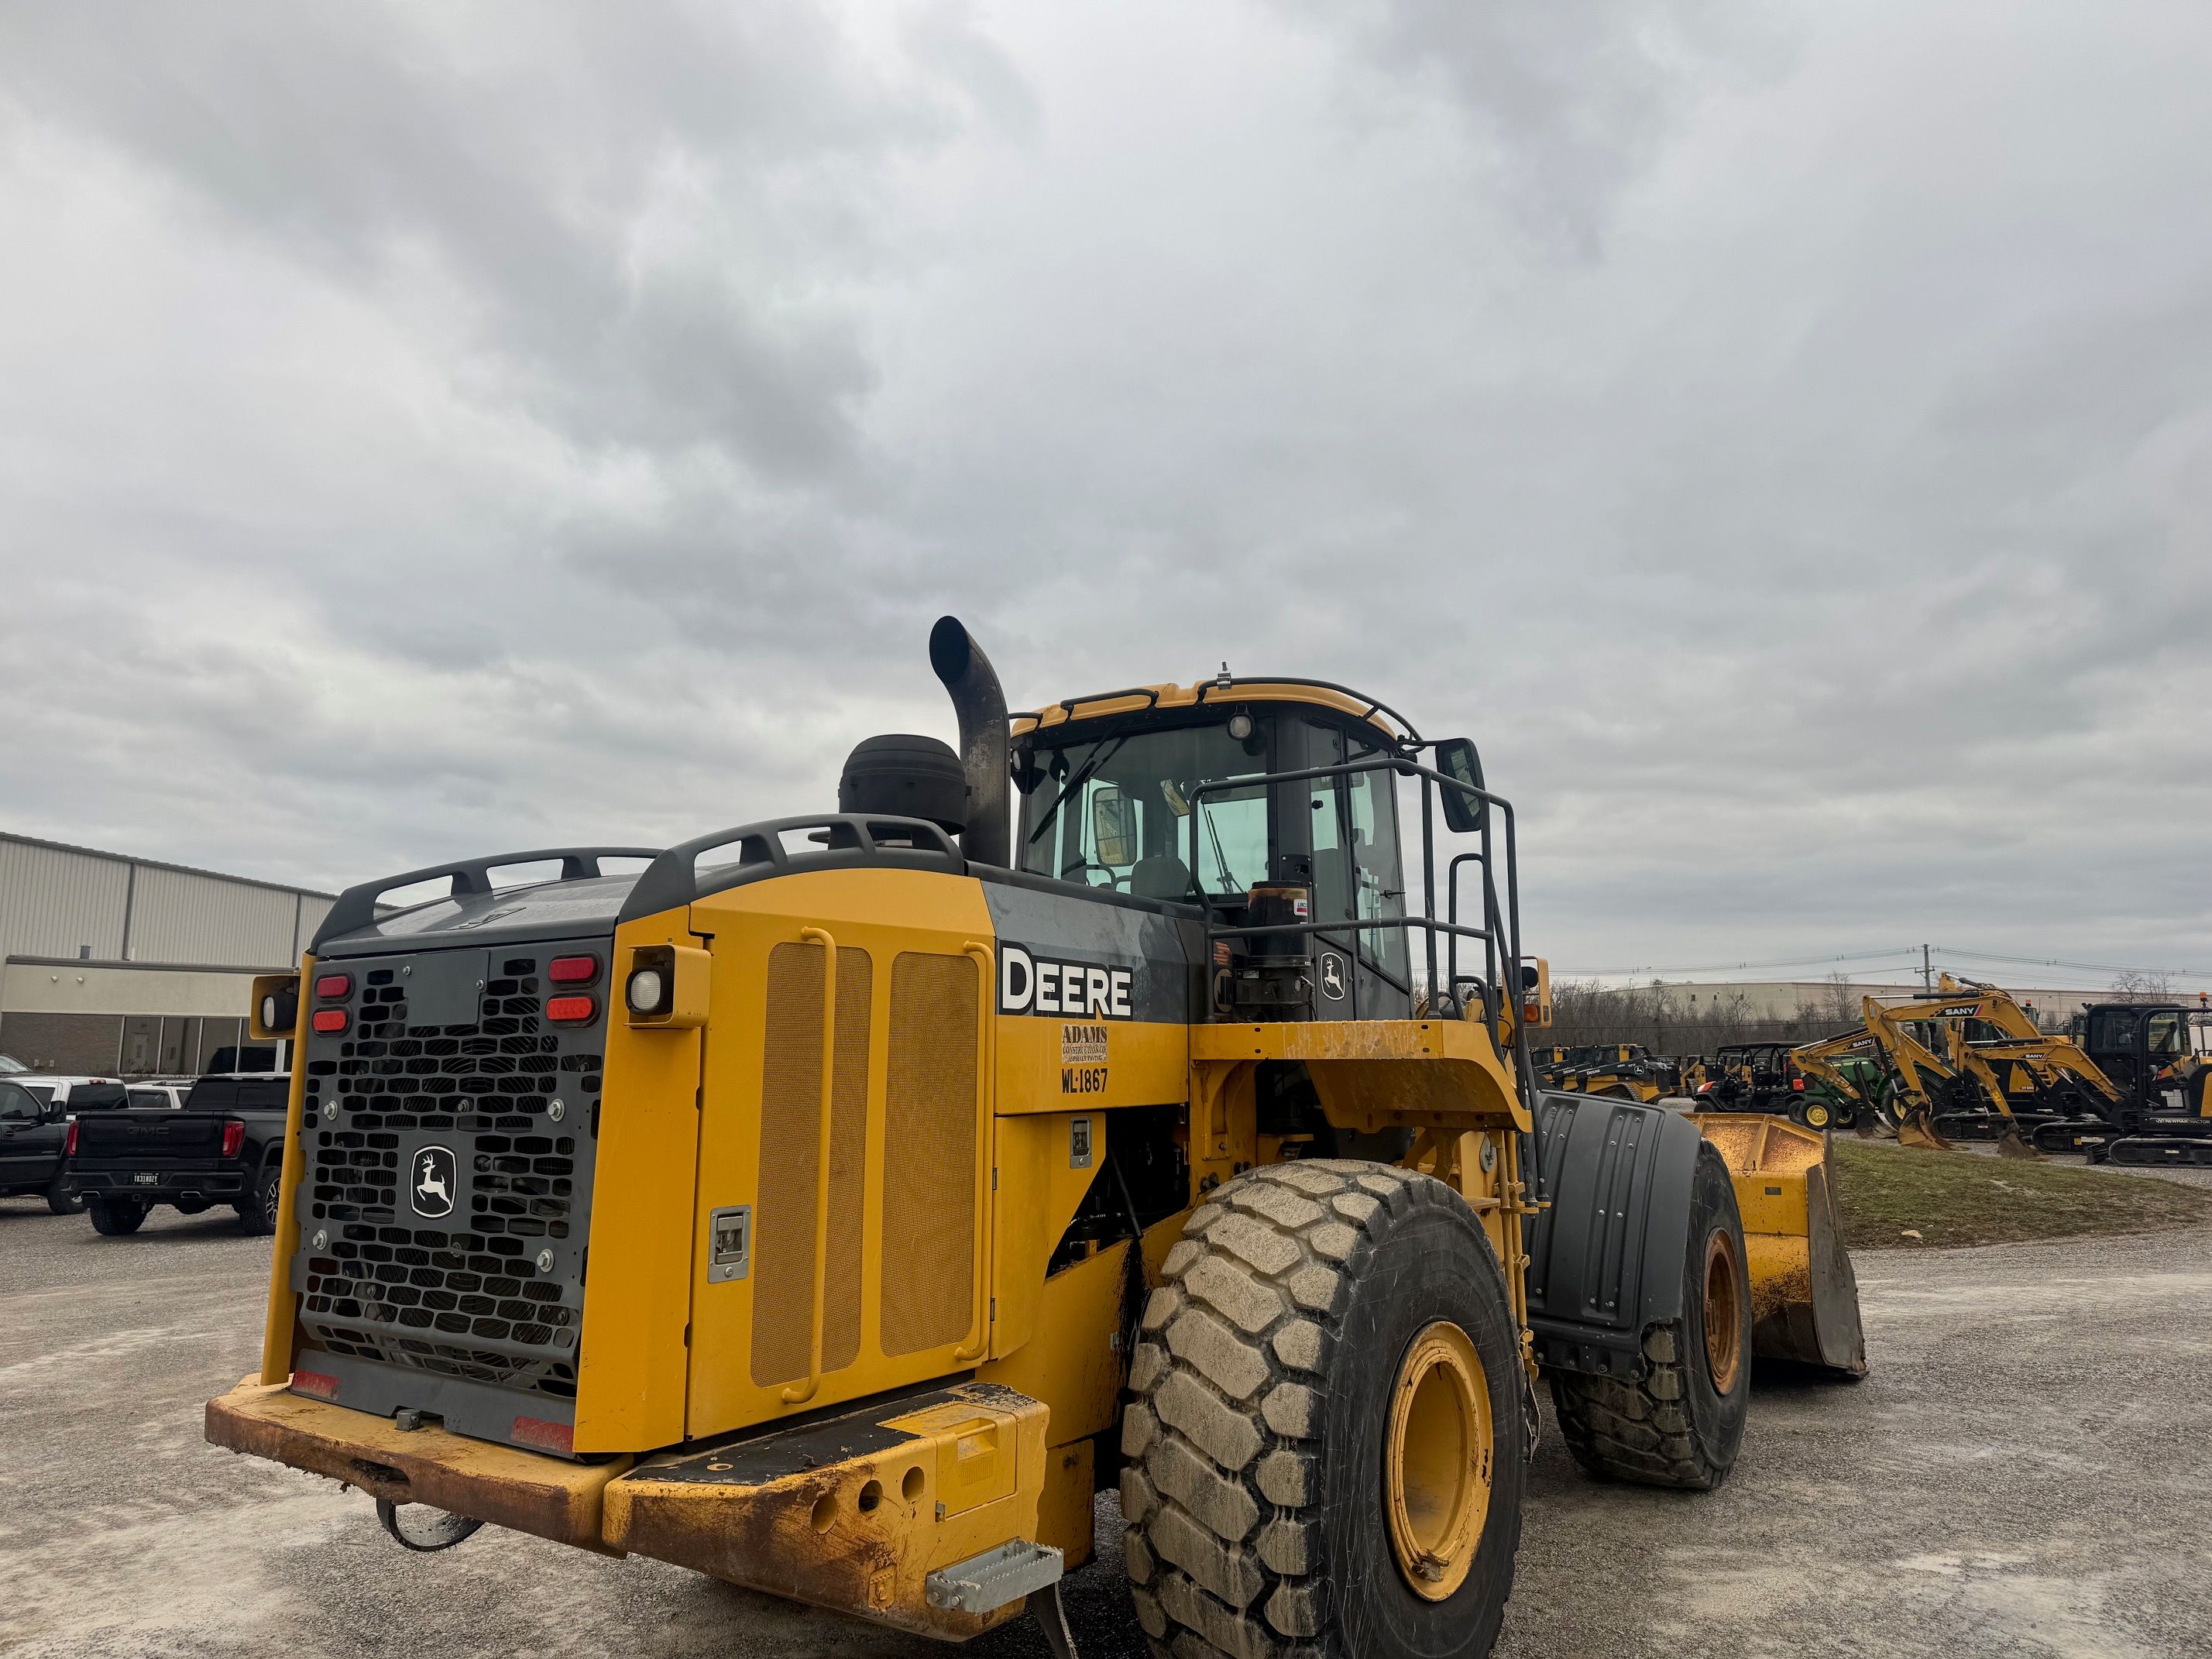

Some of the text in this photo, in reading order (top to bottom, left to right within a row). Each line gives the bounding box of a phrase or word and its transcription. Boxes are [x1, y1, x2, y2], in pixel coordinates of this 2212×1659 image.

[1002, 946, 1131, 1016] DEERE
[1945, 1007, 1974, 1015] SANY
[1062, 1025, 1108, 1043] ADAMS
[1852, 1039, 1872, 1047] SANY
[127, 1126, 169, 1135] GMC
